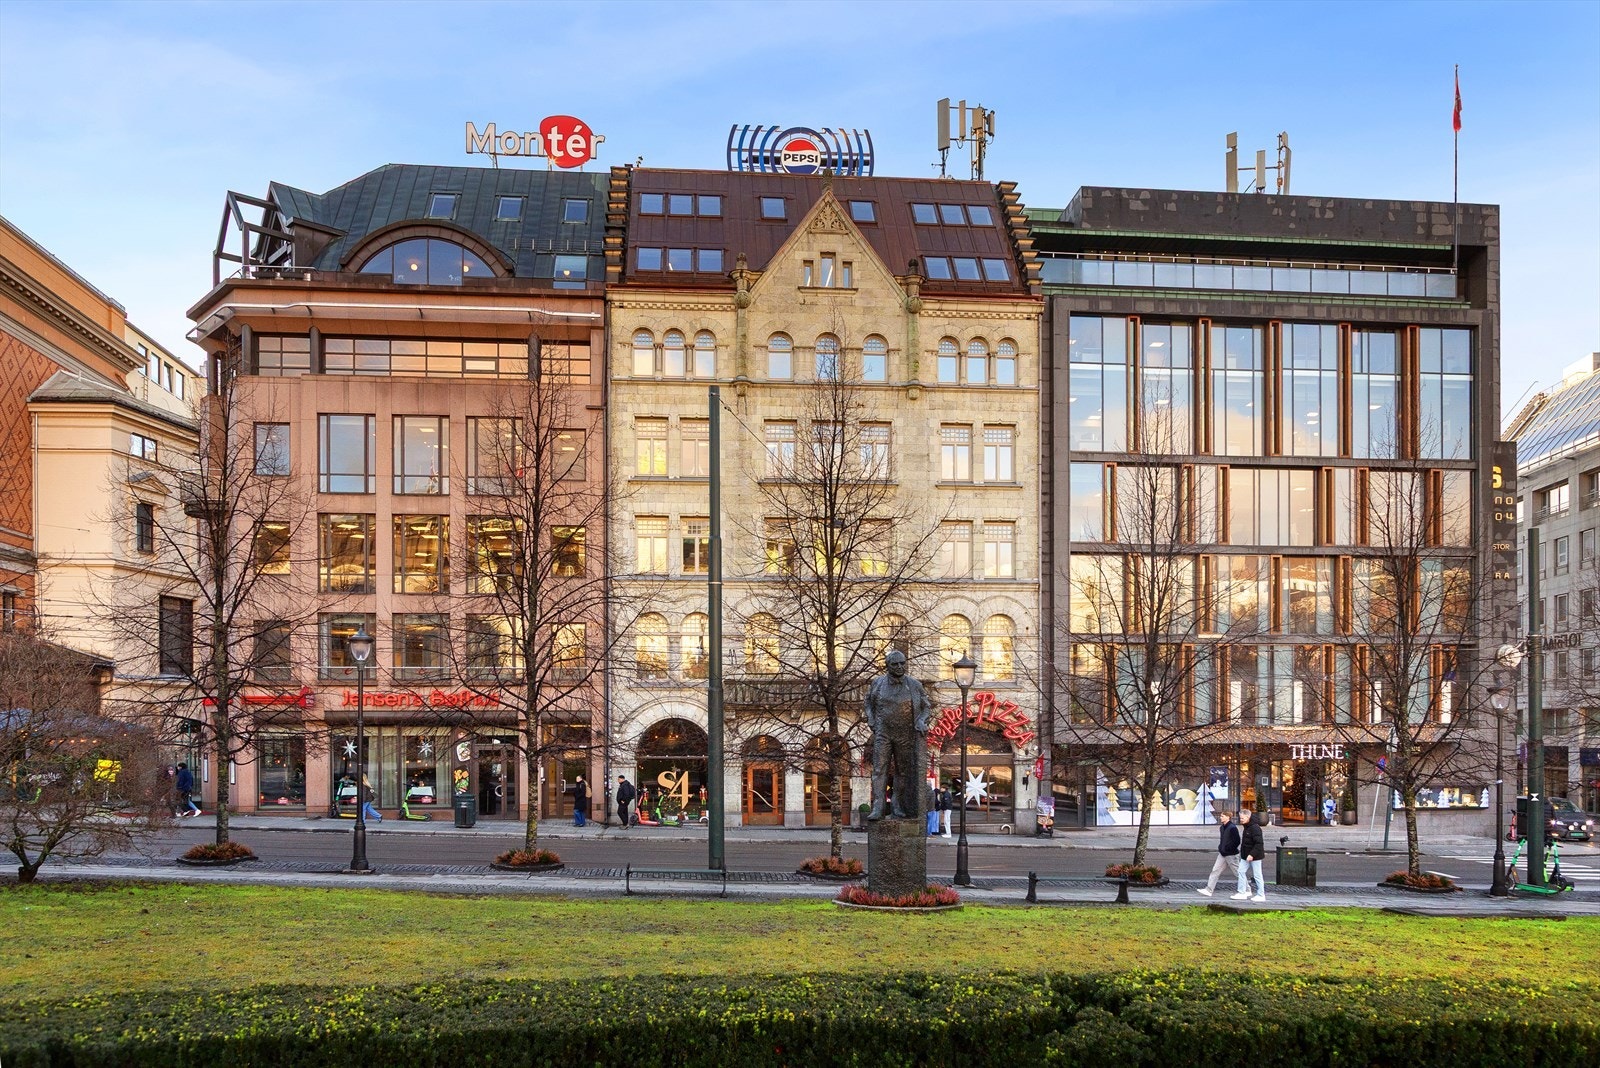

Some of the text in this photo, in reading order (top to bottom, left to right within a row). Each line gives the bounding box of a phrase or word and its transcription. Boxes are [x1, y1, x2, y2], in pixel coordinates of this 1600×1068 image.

[465, 121, 606, 159] Montér
[783, 153, 819, 163] PEPSI
[342, 690, 424, 707] Jensen's
[1289, 744, 1345, 760] THUNE
